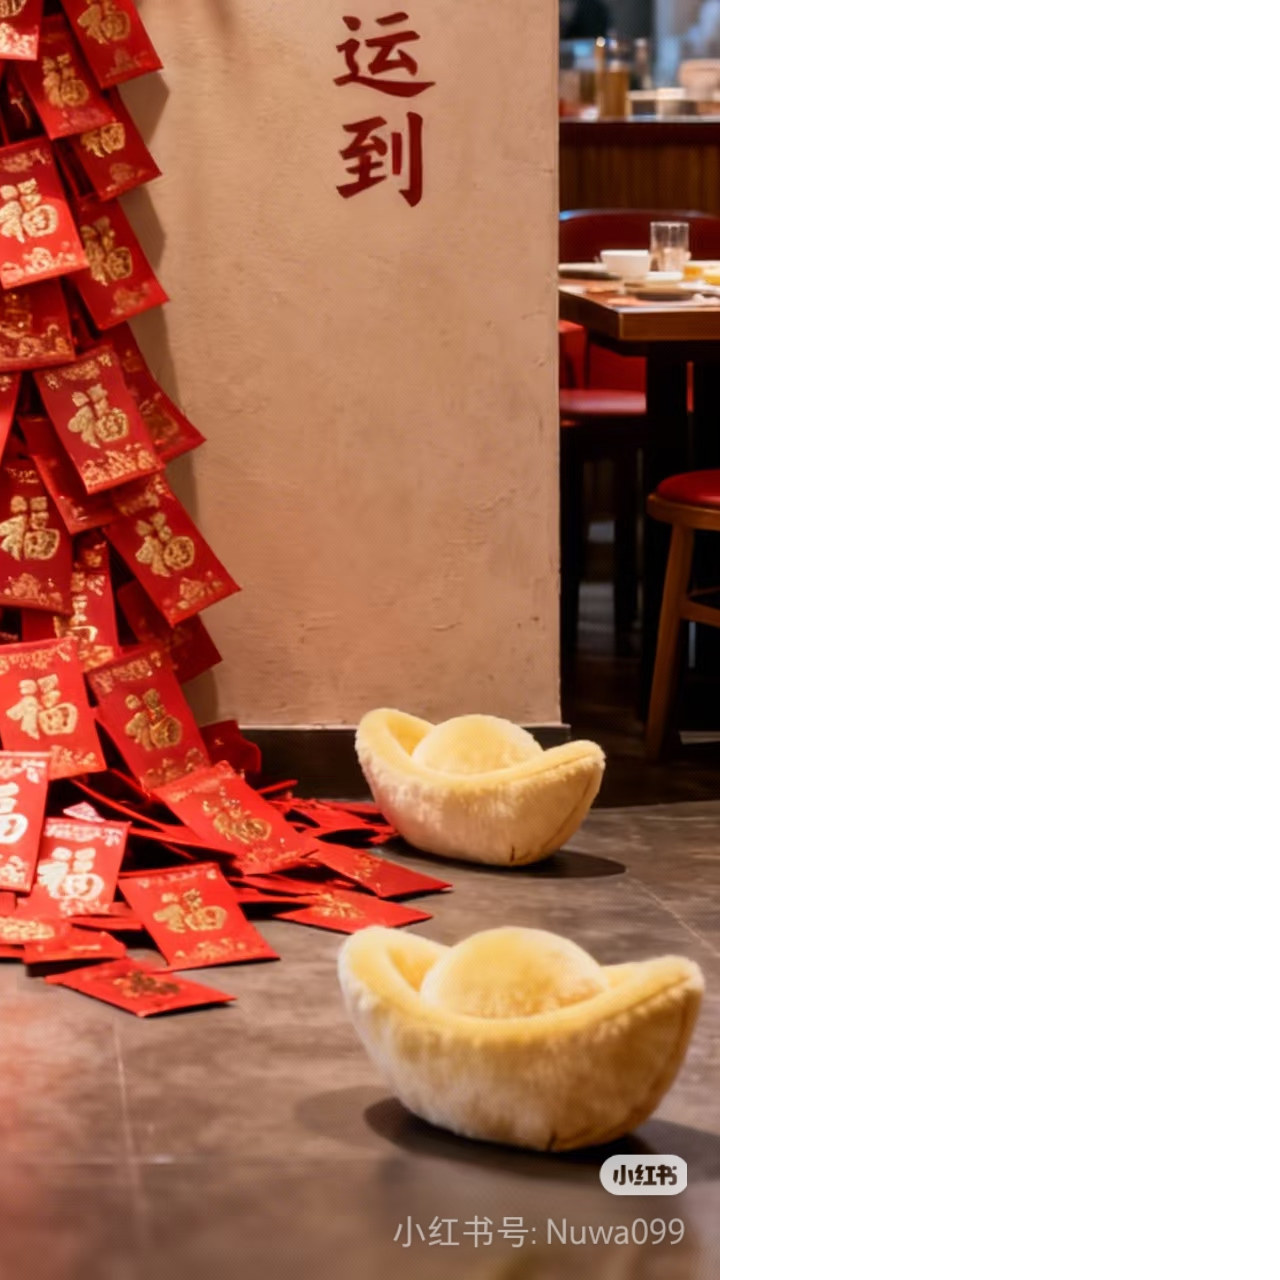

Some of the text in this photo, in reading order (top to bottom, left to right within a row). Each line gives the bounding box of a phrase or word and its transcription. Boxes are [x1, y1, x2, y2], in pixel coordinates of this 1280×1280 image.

[67, 383, 130, 448] 福
[135, 512, 196, 578] 福
[6, 674, 79, 740] 福
[124, 688, 183, 751] 福
[36, 846, 105, 900] 福
[153, 888, 228, 933] 福
